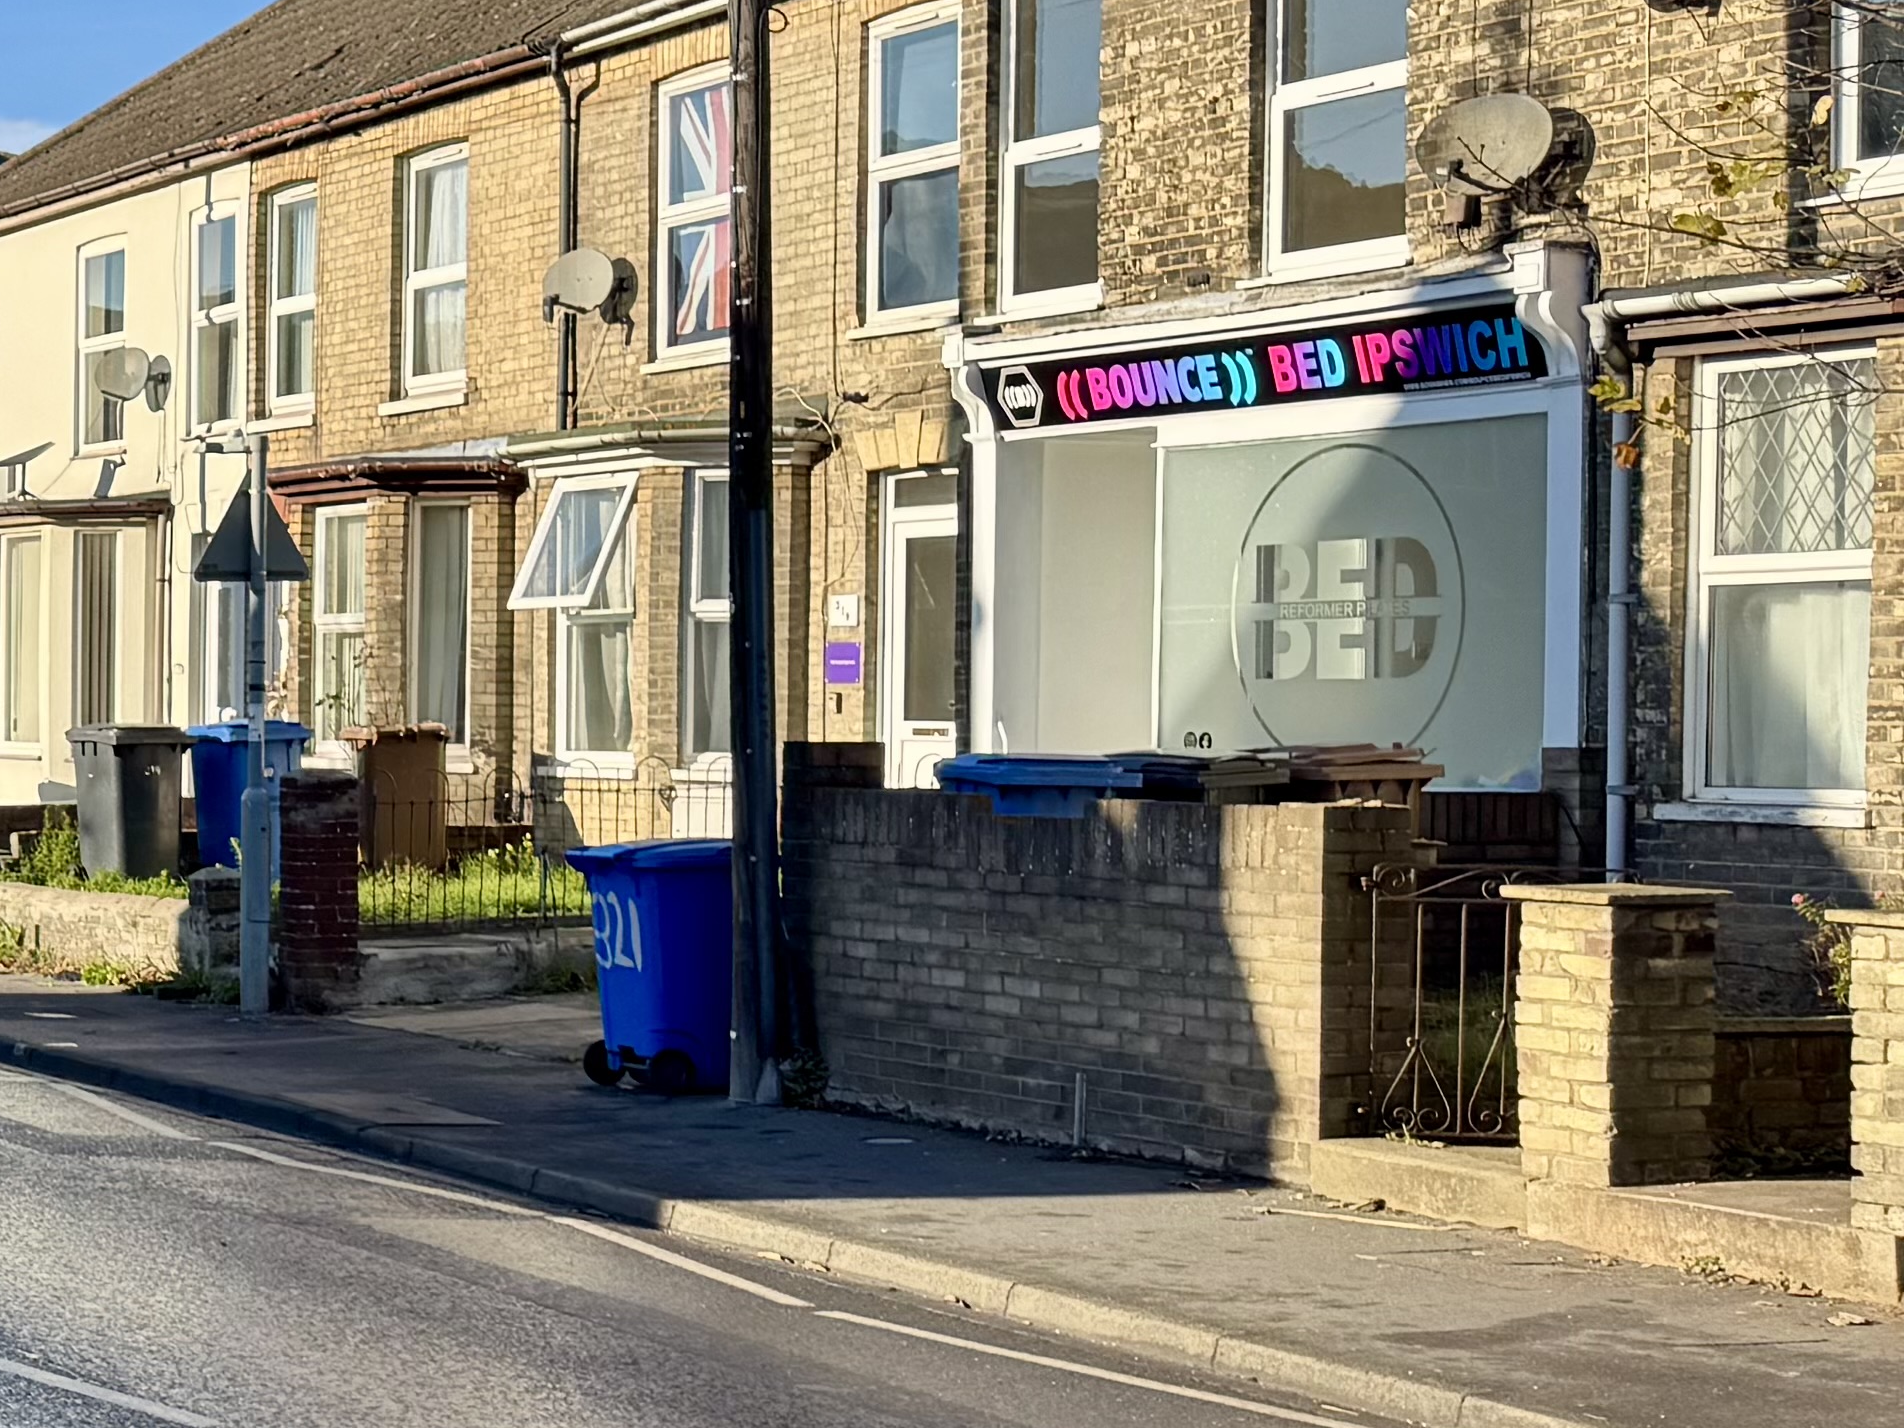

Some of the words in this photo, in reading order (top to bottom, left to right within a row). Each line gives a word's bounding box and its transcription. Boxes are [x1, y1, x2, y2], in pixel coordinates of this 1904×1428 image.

[1268, 338, 1346, 393] BED
[1352, 316, 1529, 384] IPSWICH
[1279, 601, 1353, 619] REFORMER
